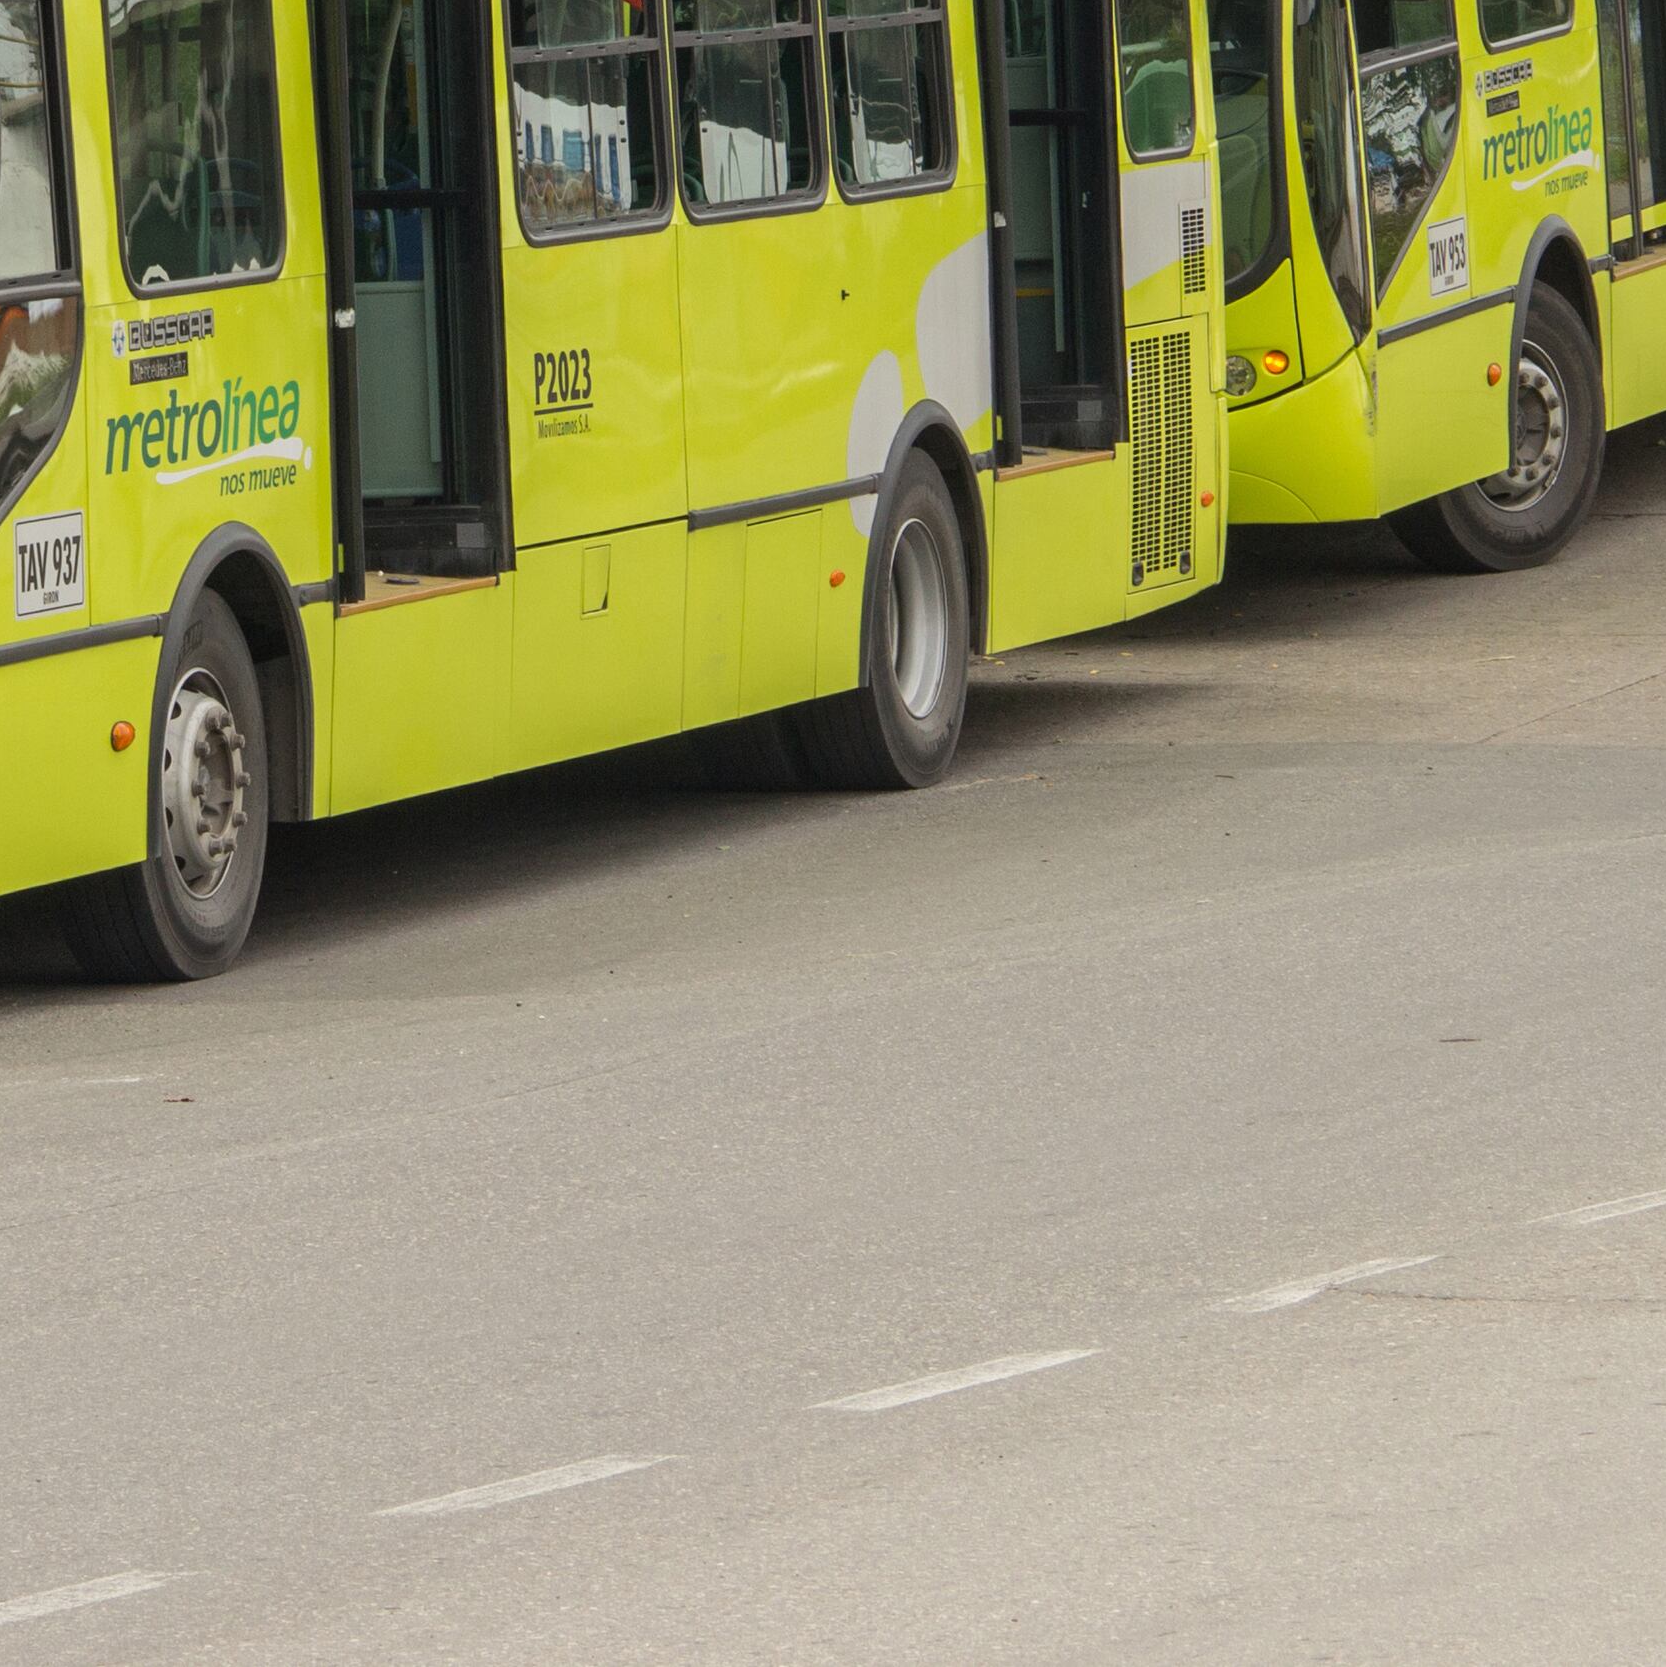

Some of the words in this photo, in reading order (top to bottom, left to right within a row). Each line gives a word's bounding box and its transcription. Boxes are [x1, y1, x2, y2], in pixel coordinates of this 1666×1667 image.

[1483, 103, 1593, 182] metrolínea
[1544, 178, 1560, 198] nos
[1561, 170, 1589, 193] mueve
[1429, 238, 1447, 279] TAV
[1448, 233, 1466, 272] 953
[127, 308, 214, 352] BUSSCAR
[132, 355, 187, 384] Mercedes-Benz
[533, 347, 592, 406] P2023
[104, 375, 301, 476] metrolínea
[537, 417, 578, 439] Movilizamos
[219, 474, 246, 497] nos
[247, 463, 298, 490] mueve
[18, 540, 48, 594] TAV
[52, 535, 81, 588] 937
